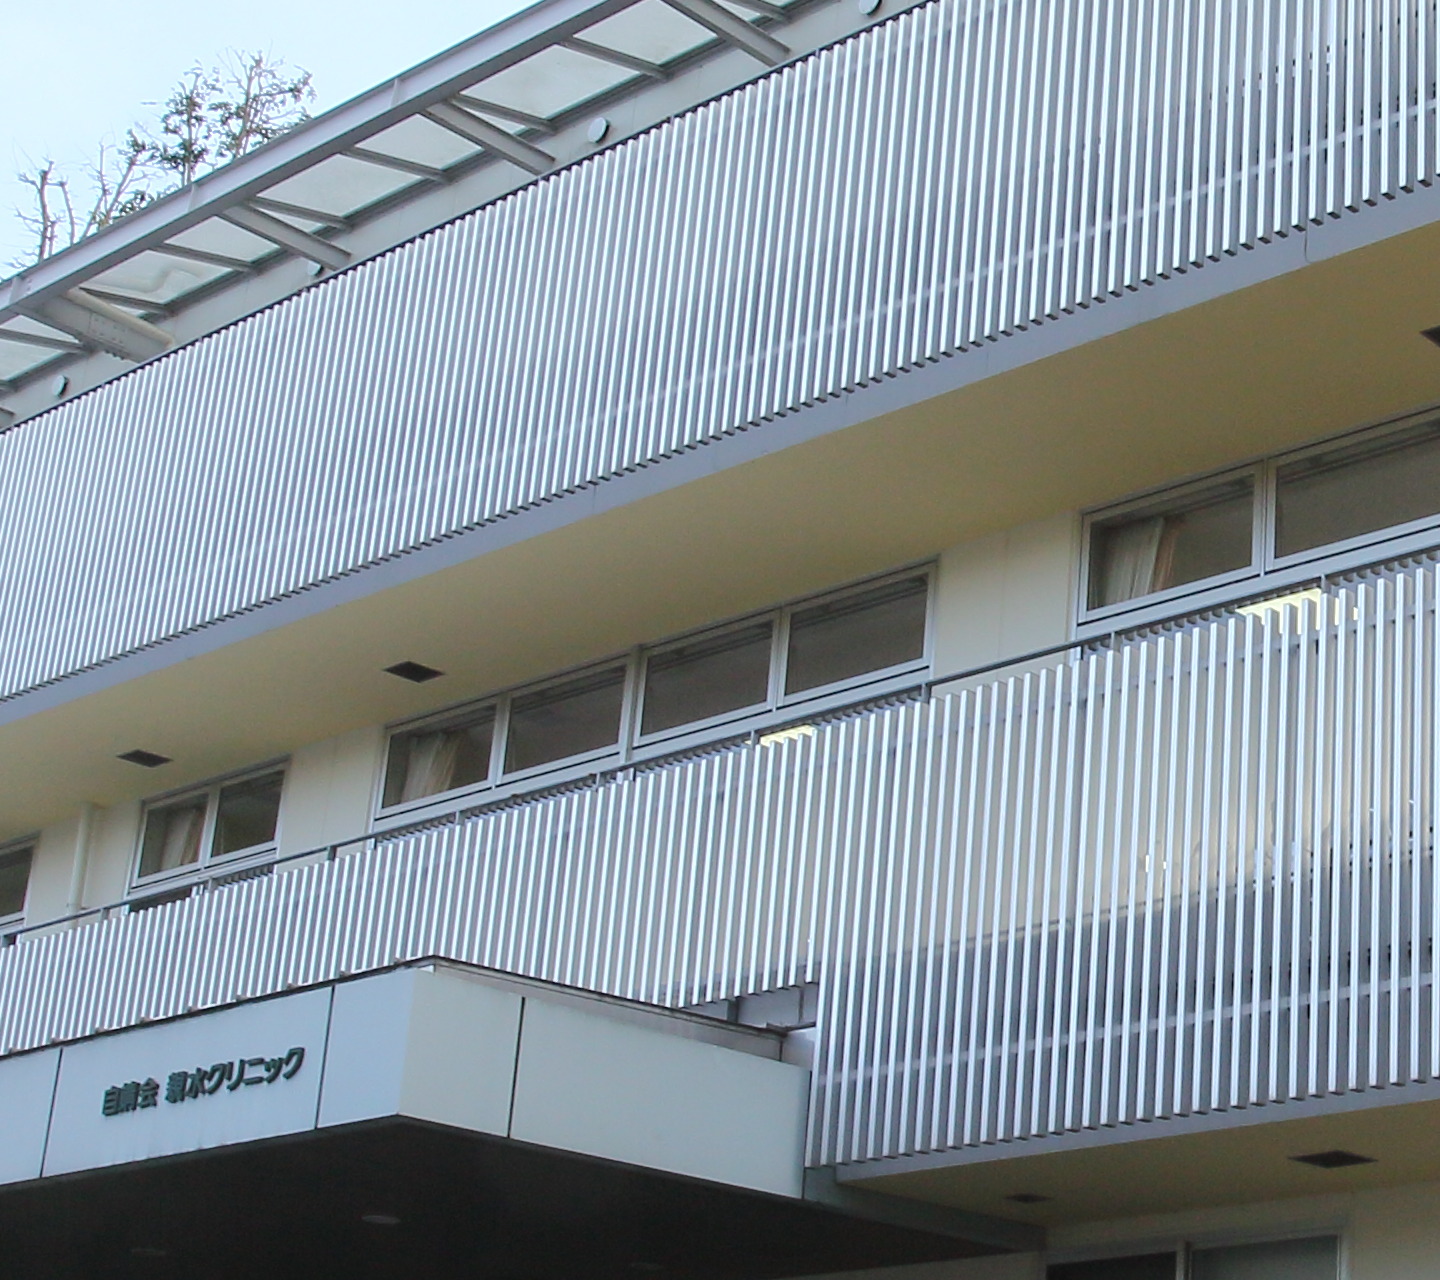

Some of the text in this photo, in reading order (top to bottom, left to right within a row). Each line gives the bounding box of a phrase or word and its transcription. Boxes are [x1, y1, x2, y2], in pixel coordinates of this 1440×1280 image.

[165, 1046, 306, 1104] 親水クリニック
